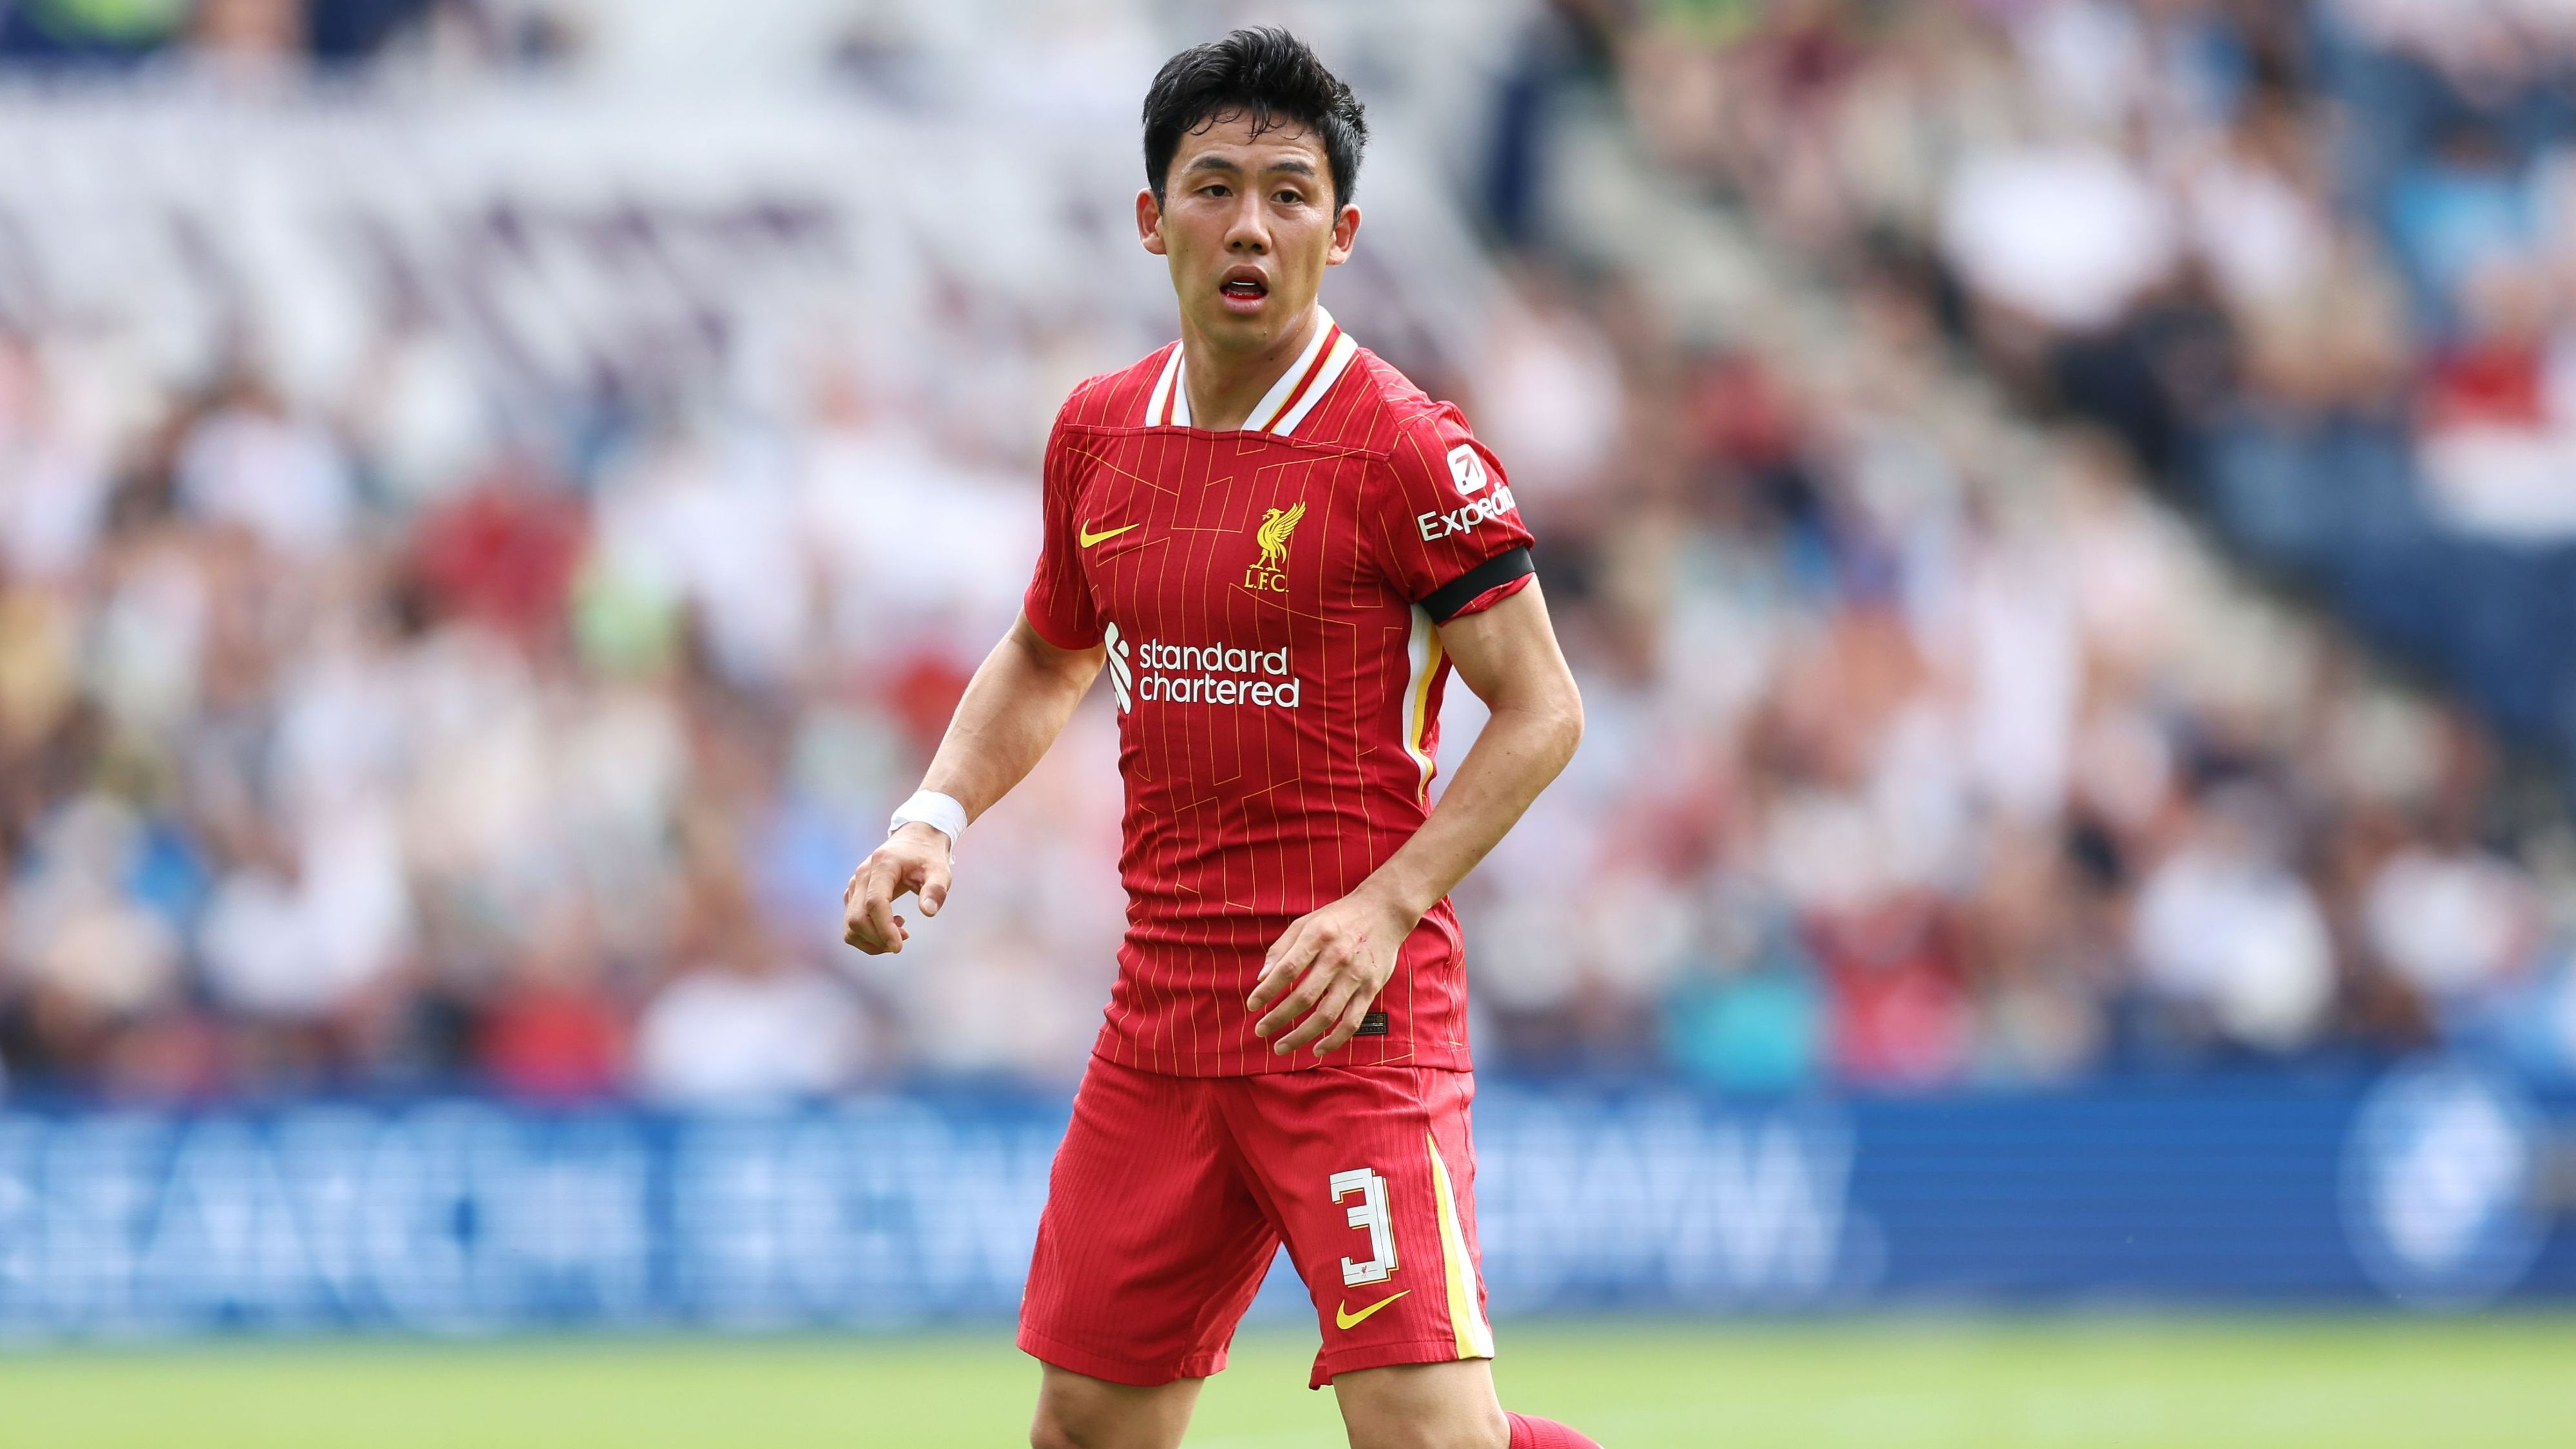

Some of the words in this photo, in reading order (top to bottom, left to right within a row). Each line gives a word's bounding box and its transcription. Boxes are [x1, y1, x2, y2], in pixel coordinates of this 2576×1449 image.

[1244, 569, 1289, 592] L.F.C.
[1139, 638, 1287, 675] standard
[1139, 670, 1300, 707] chartered
[1329, 1168, 1399, 1288] 3
